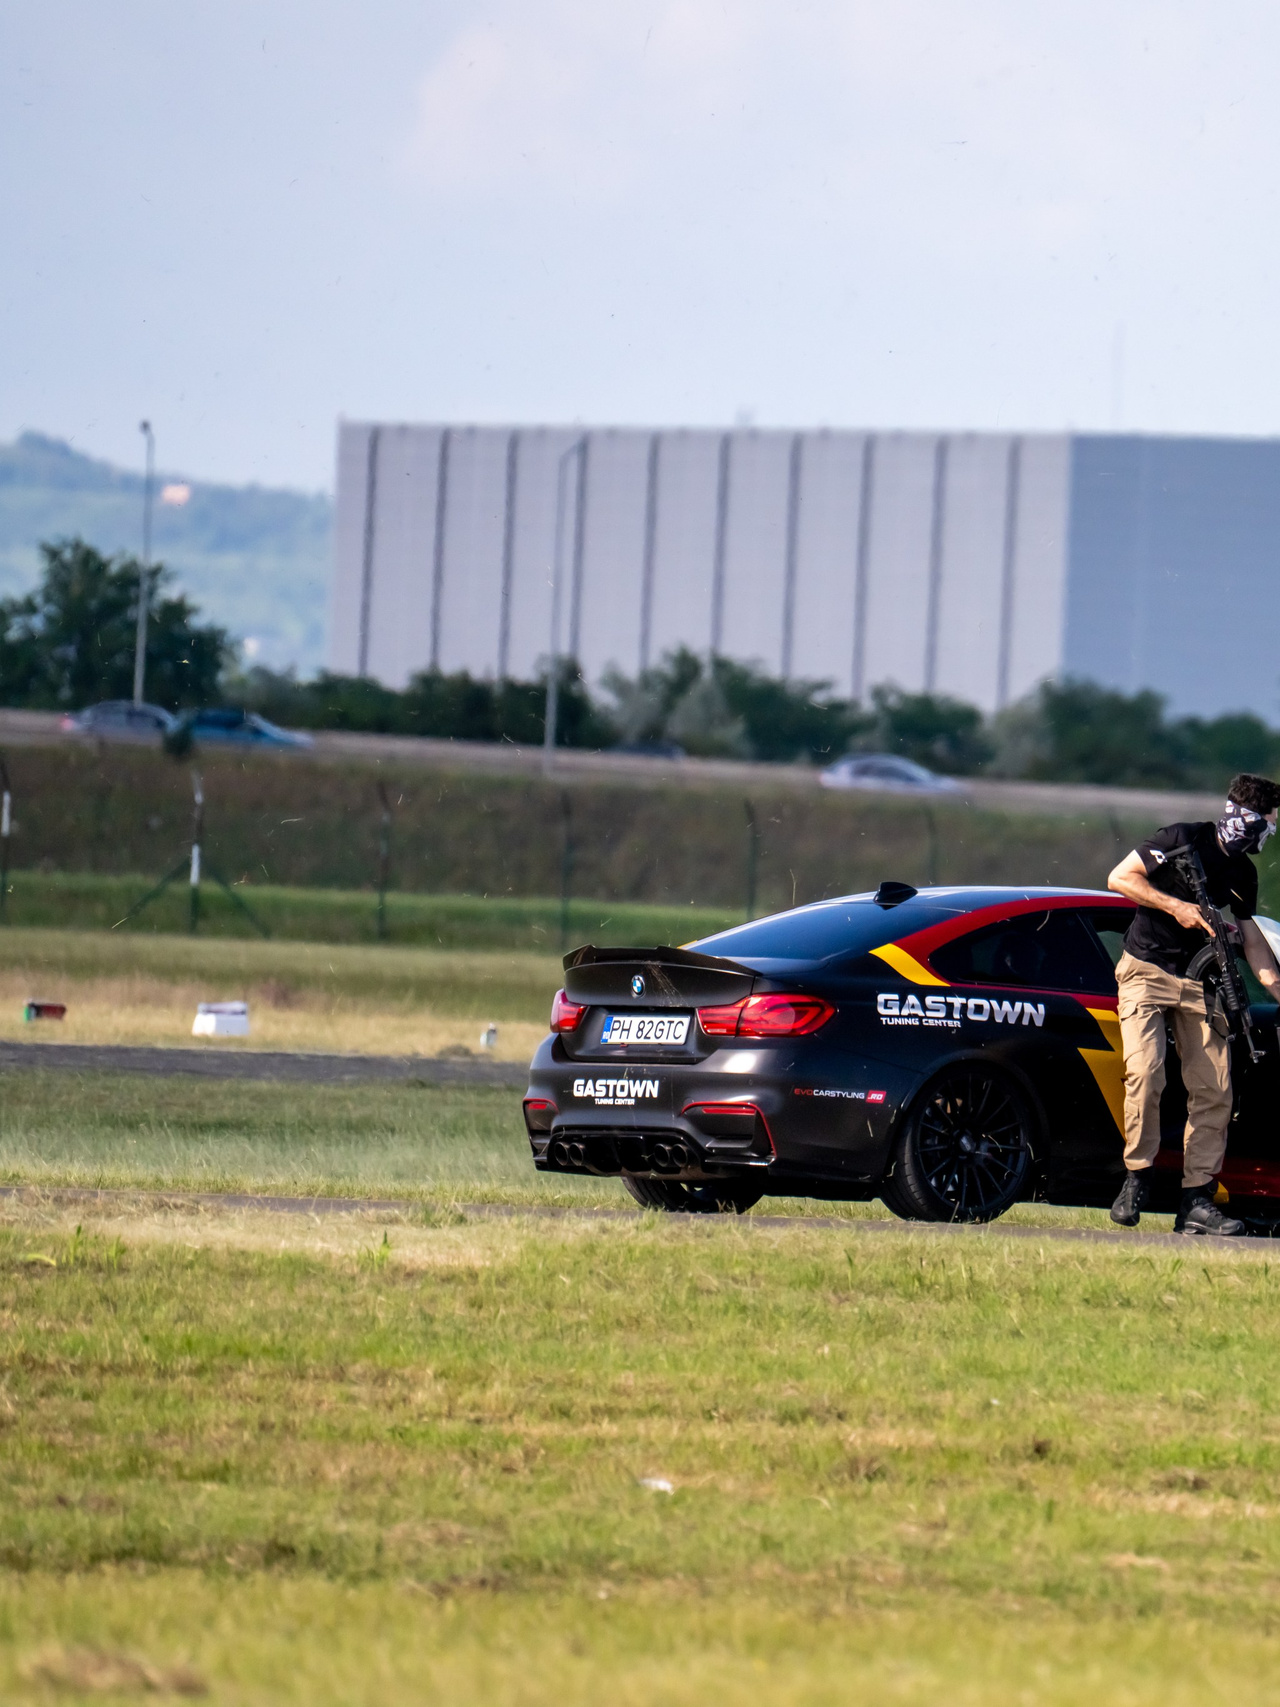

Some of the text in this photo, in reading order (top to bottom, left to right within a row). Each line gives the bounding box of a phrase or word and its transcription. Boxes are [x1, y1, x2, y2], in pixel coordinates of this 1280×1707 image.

[876, 993, 1045, 1027] GASTOWN
[609, 1019, 684, 1040] PH 82GTC
[880, 1017, 961, 1028] TUNING CENTER
[573, 1079, 659, 1098] GASTOWN
